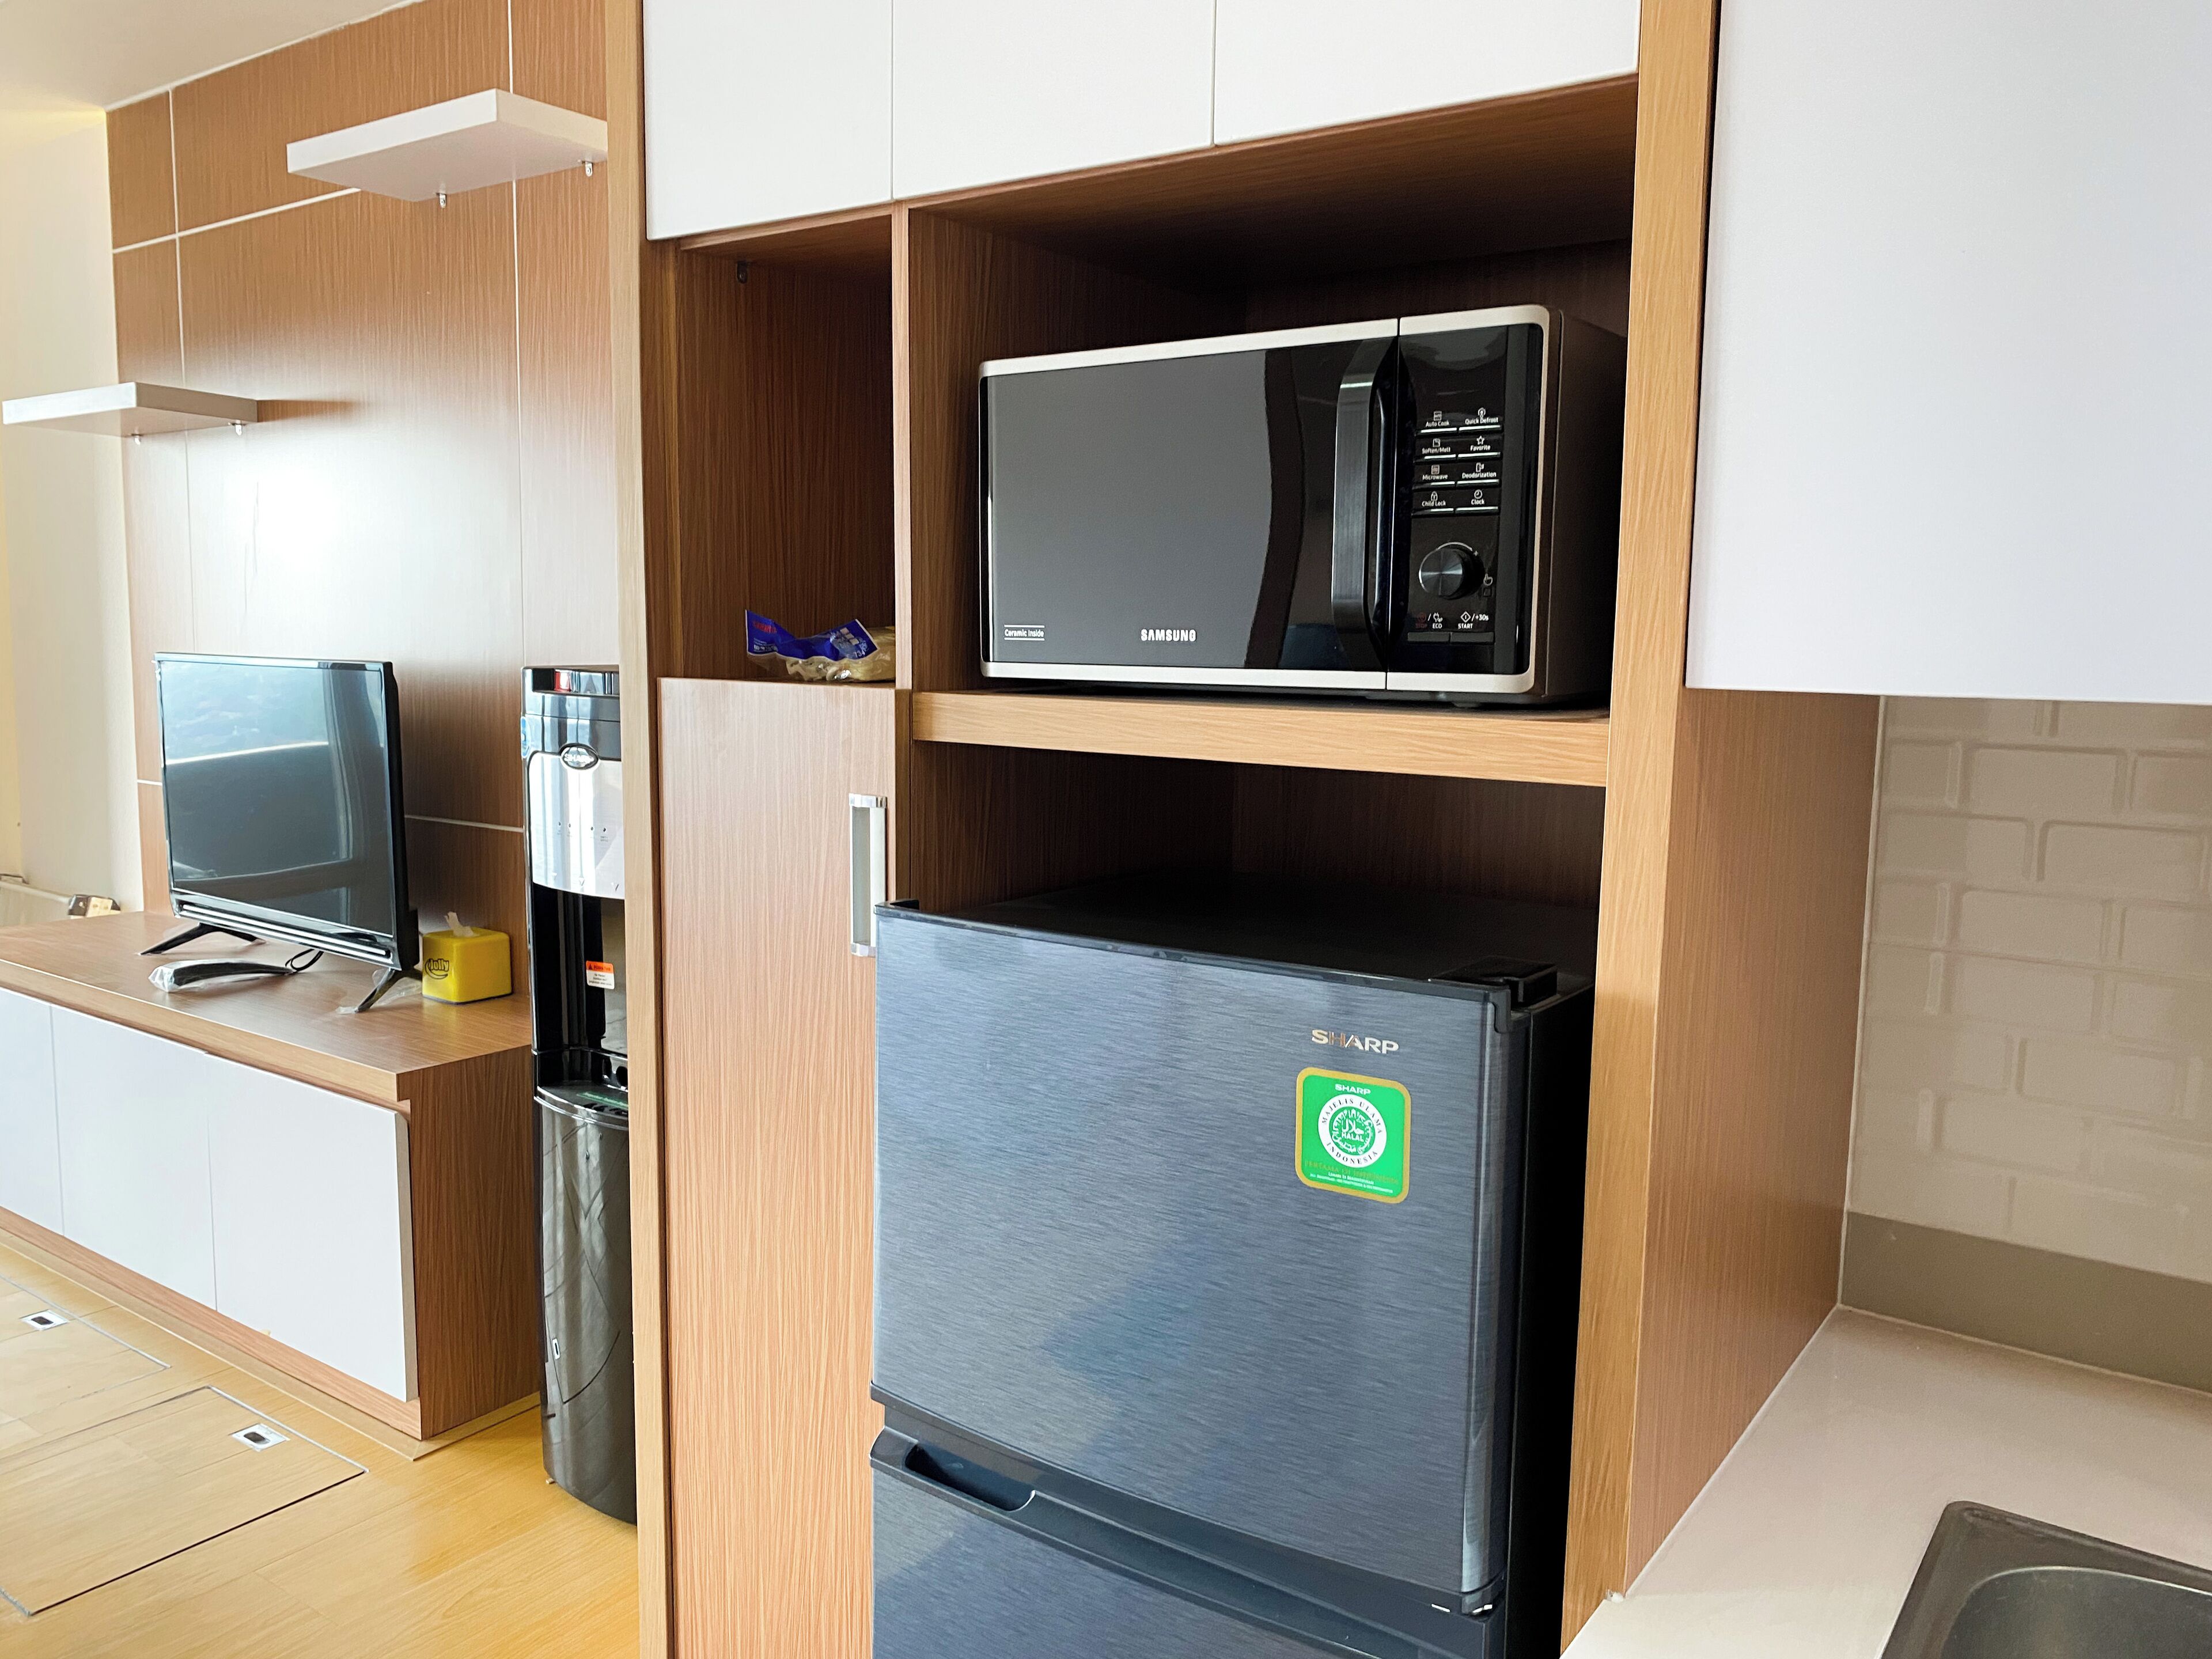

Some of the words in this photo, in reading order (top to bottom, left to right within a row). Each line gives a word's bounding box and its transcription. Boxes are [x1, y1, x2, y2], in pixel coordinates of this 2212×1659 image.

[1004, 628, 1028, 637] Ceramic
[1028, 628, 1044, 637] Inside
[1141, 628, 1196, 642] SAMSUNG
[1311, 1029, 1399, 1054] SHARP
[1335, 1083, 1371, 1095] SHARP
[1321, 1098, 1354, 1124] MAJELIS
[1359, 1101, 1382, 1134] ULAMA
[1341, 1131, 1365, 1142] HALAL
[1326, 1142, 1378, 1164] INDONESIA
